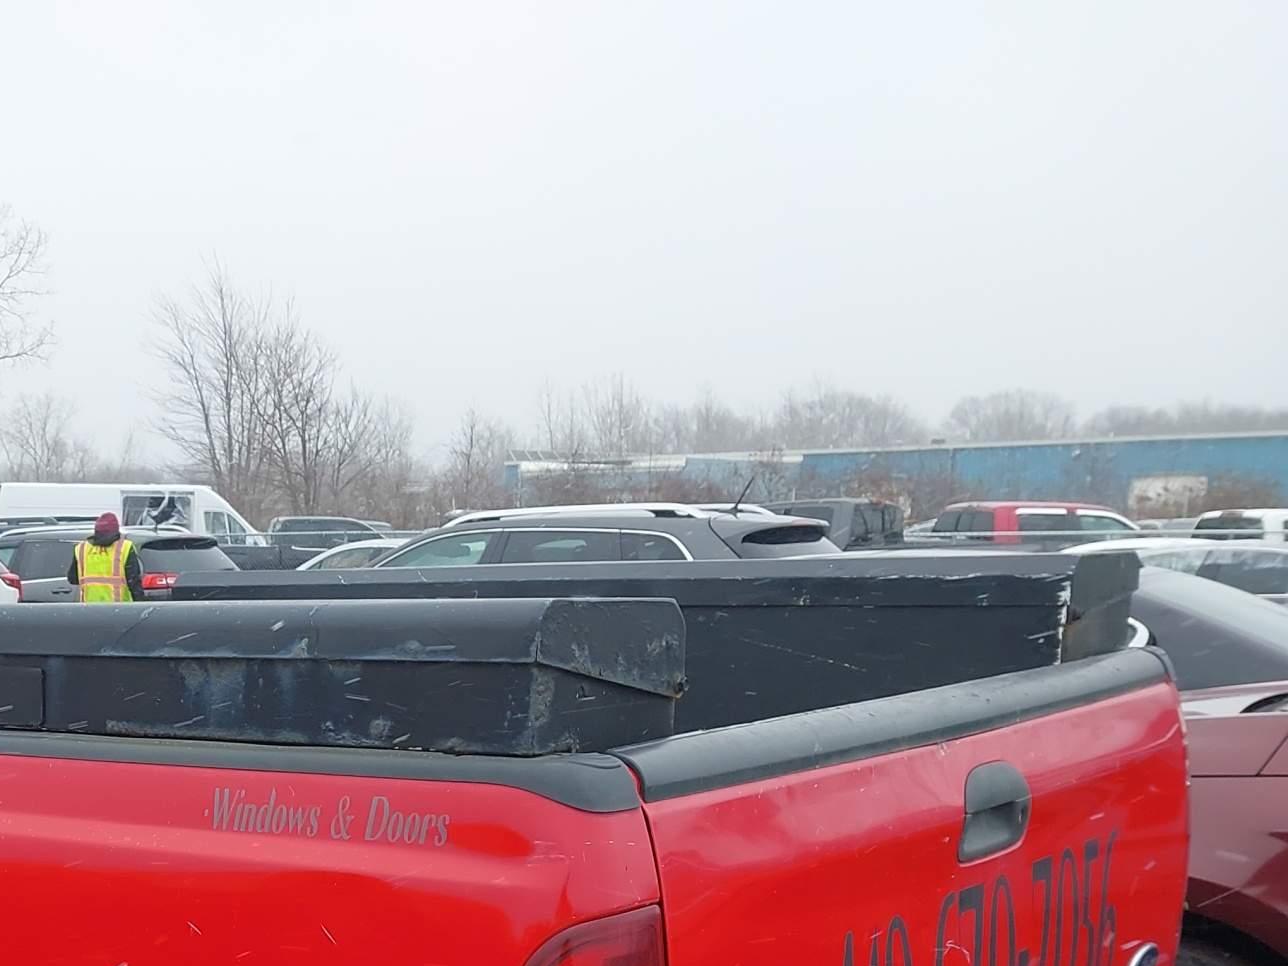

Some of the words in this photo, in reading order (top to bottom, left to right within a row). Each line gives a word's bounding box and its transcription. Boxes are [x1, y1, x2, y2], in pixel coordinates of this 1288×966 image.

[212, 786, 322, 838] Windows
[330, 794, 355, 841] &
[364, 795, 451, 848] Doors
